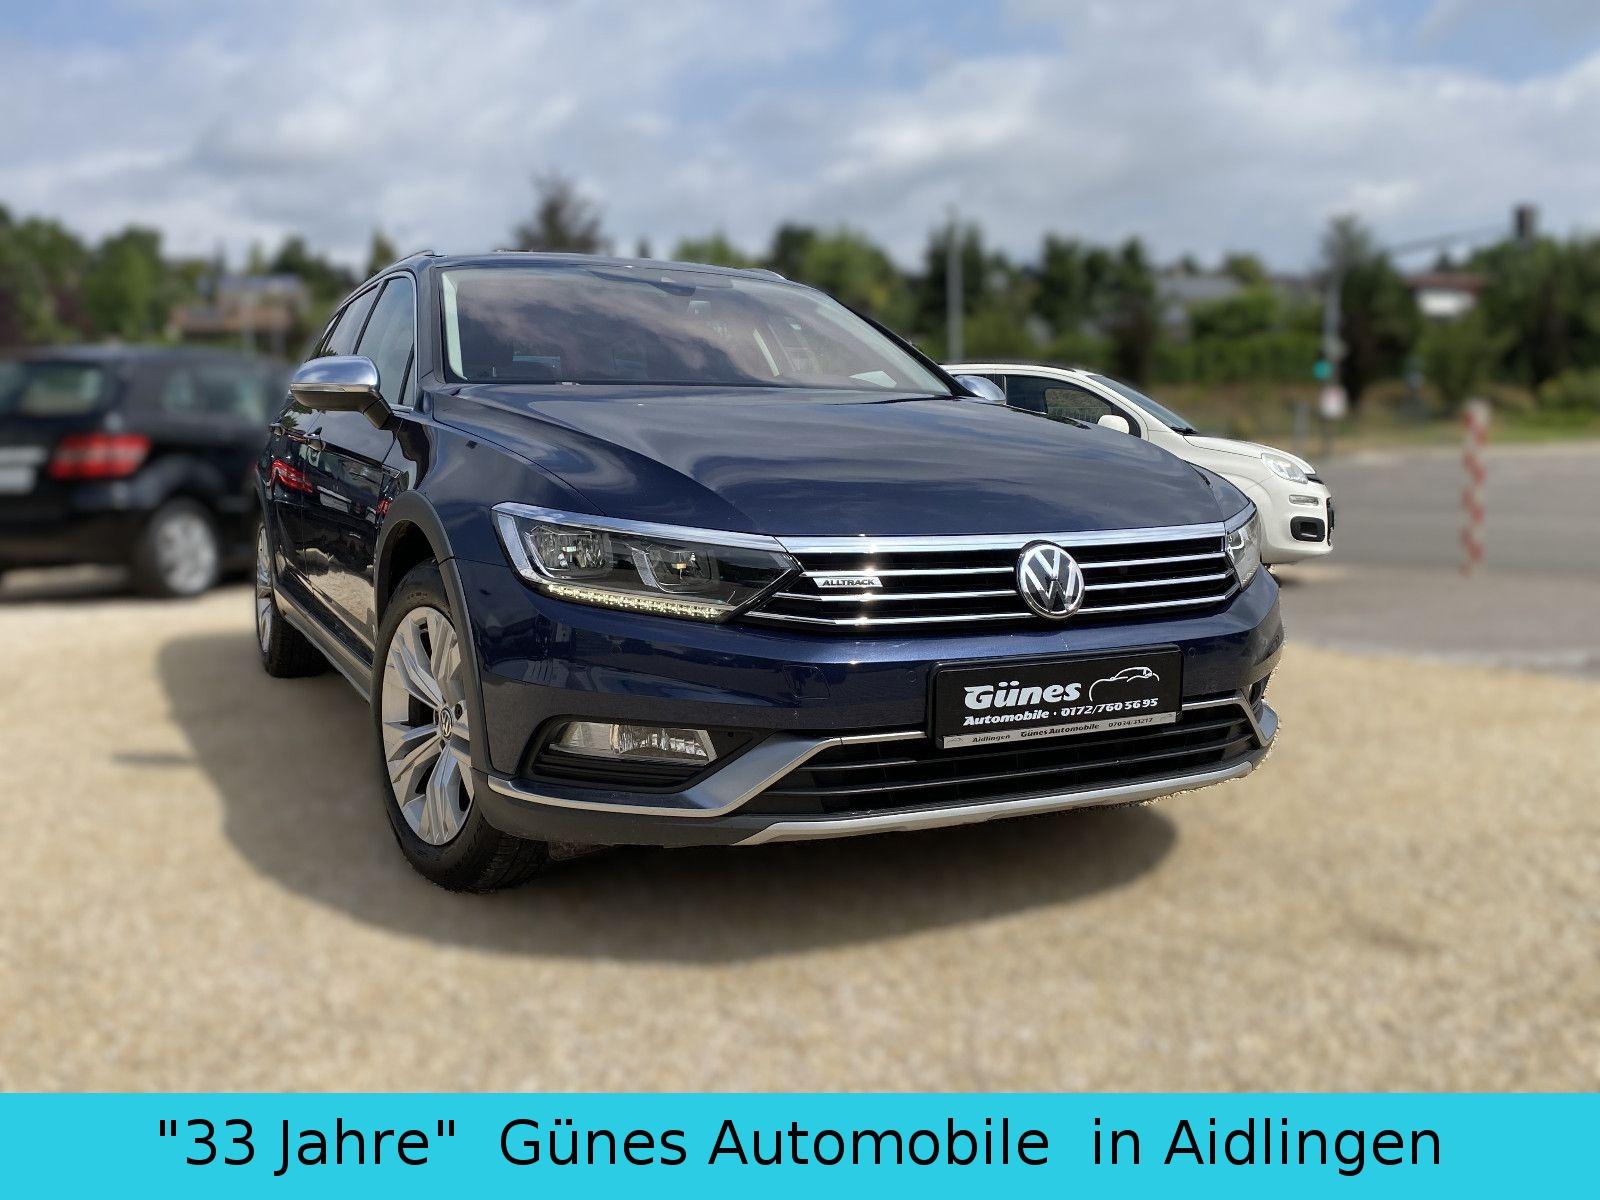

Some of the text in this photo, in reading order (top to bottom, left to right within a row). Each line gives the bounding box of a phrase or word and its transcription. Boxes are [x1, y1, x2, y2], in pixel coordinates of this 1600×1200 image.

[1018, 543, 1084, 617] VW
[963, 680, 1082, 710] Günes
[963, 698, 1159, 727] Automobile 0172/760 56 95
[972, 734, 1011, 743] Aidlingen
[1020, 729, 1048, 738] Günes
[1048, 723, 1100, 735] Automobile
